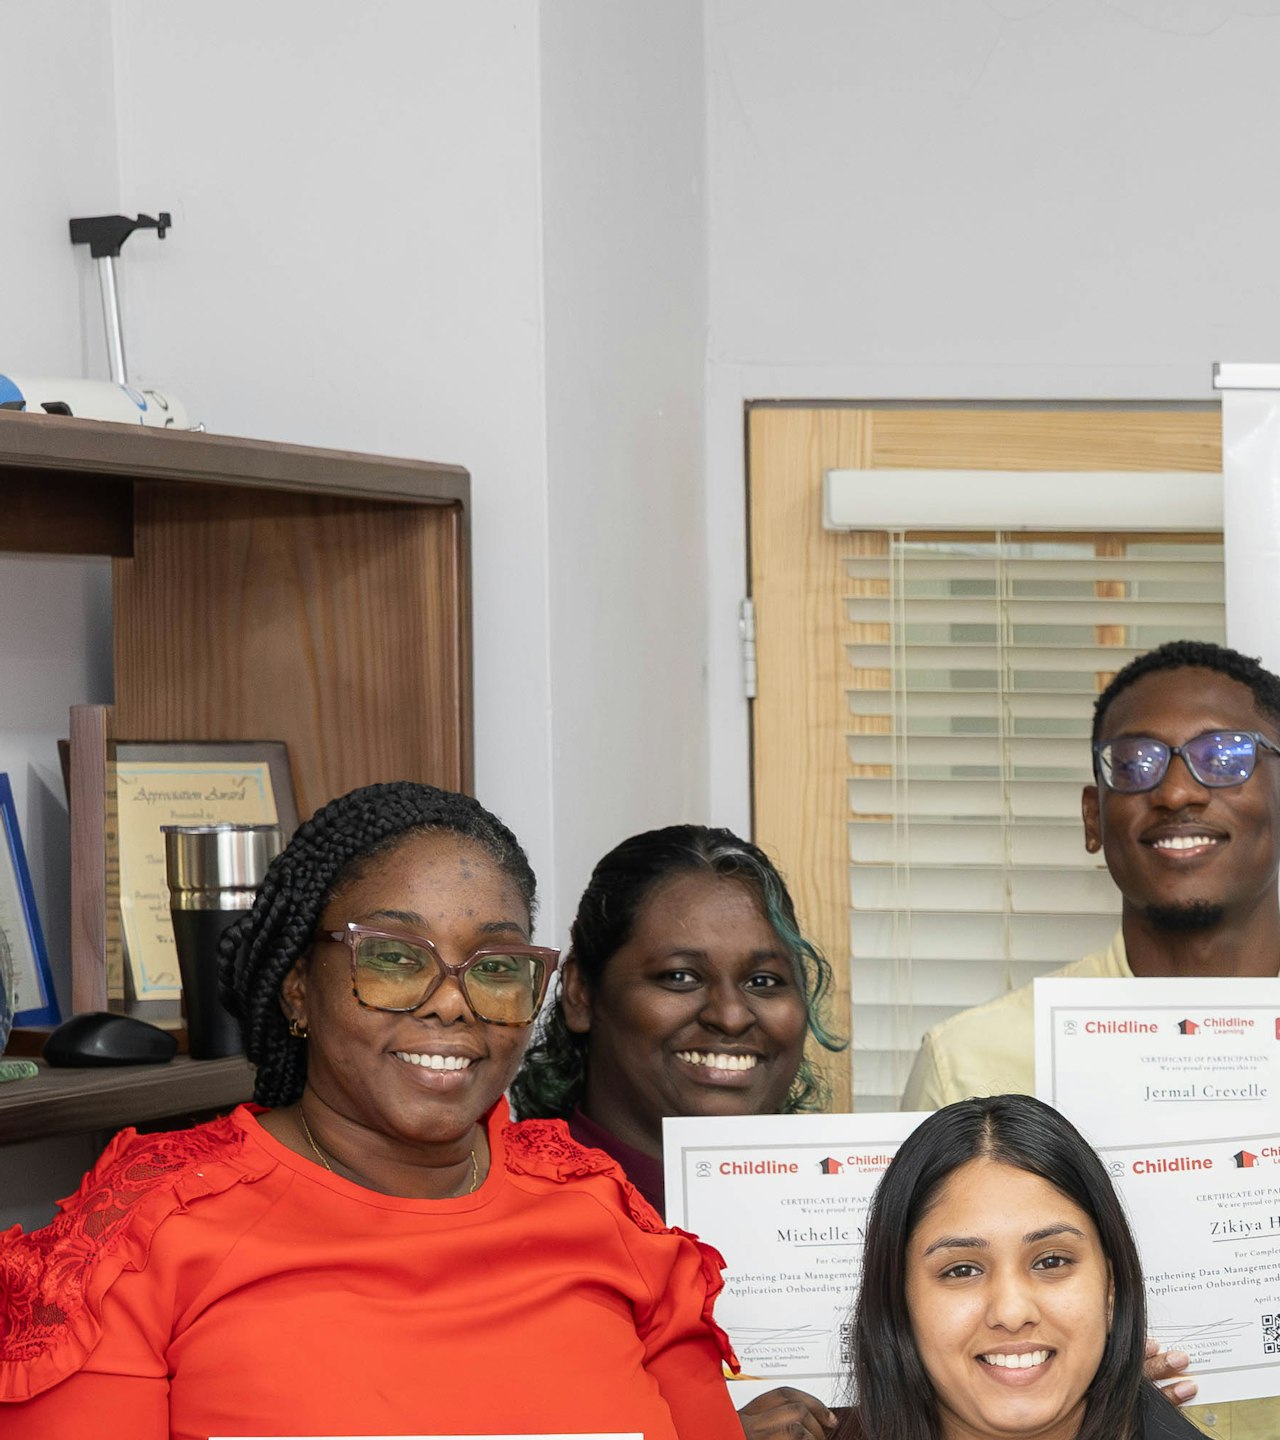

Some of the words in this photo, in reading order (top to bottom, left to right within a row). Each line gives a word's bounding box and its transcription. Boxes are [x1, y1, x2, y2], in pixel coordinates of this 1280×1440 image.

[1085, 1020, 1158, 1034] Childline
[1203, 1017, 1255, 1028] Childline
[1143, 1084, 1195, 1101] Jermal
[1202, 1083, 1267, 1097] Crevelle
[719, 1160, 799, 1175] Childline
[846, 1155, 894, 1166] Childlin
[1132, 1157, 1213, 1175] Childline
[858, 1165, 888, 1173] Learnin
[777, 1226, 849, 1242] Michelle
[1210, 1216, 1262, 1239] Zikiya
